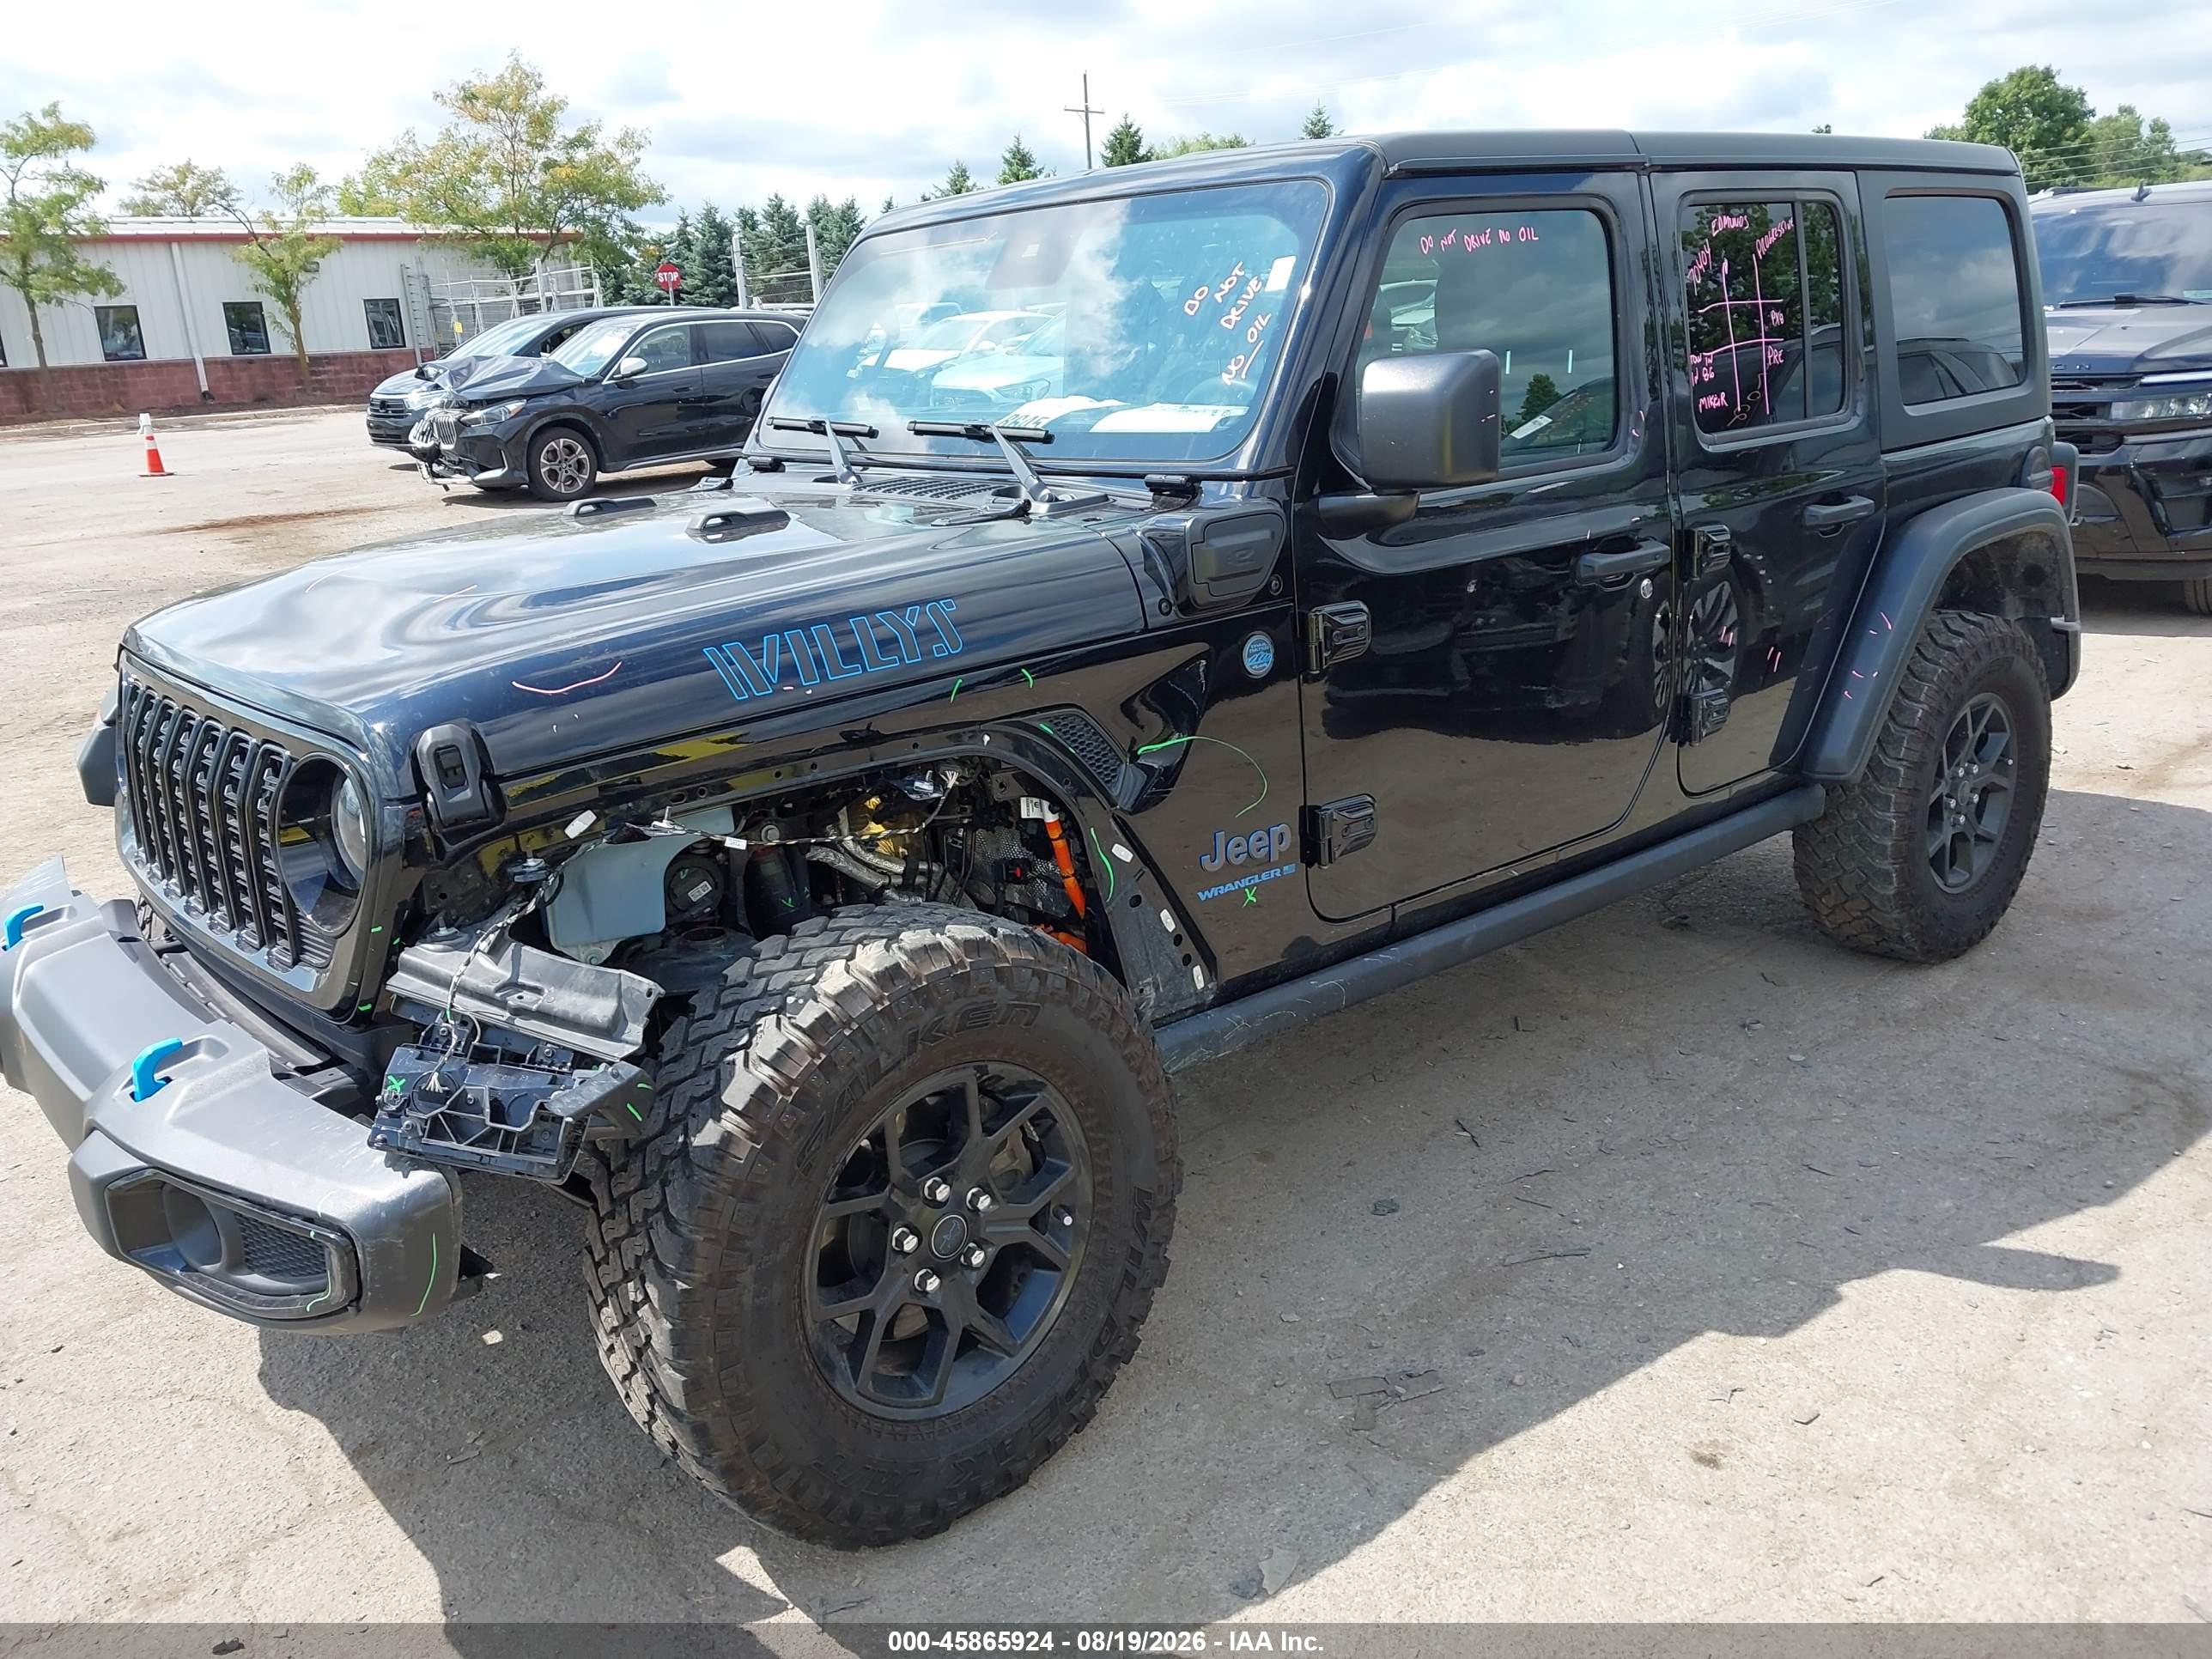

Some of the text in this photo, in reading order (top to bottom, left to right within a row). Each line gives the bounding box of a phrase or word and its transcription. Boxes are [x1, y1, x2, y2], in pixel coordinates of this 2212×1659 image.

[1419, 227, 1539, 254] DO NOT DRIVE NO OIL
[658, 271, 679, 283] STOP
[1183, 260, 1245, 316] DO NOT
[1219, 276, 1263, 331] DRIVE
[1221, 312, 1272, 386] NO OIL
[702, 599, 963, 701] WILLYS
[1200, 823, 1291, 872] Jeep
[1197, 868, 1281, 902] WRANGLER
